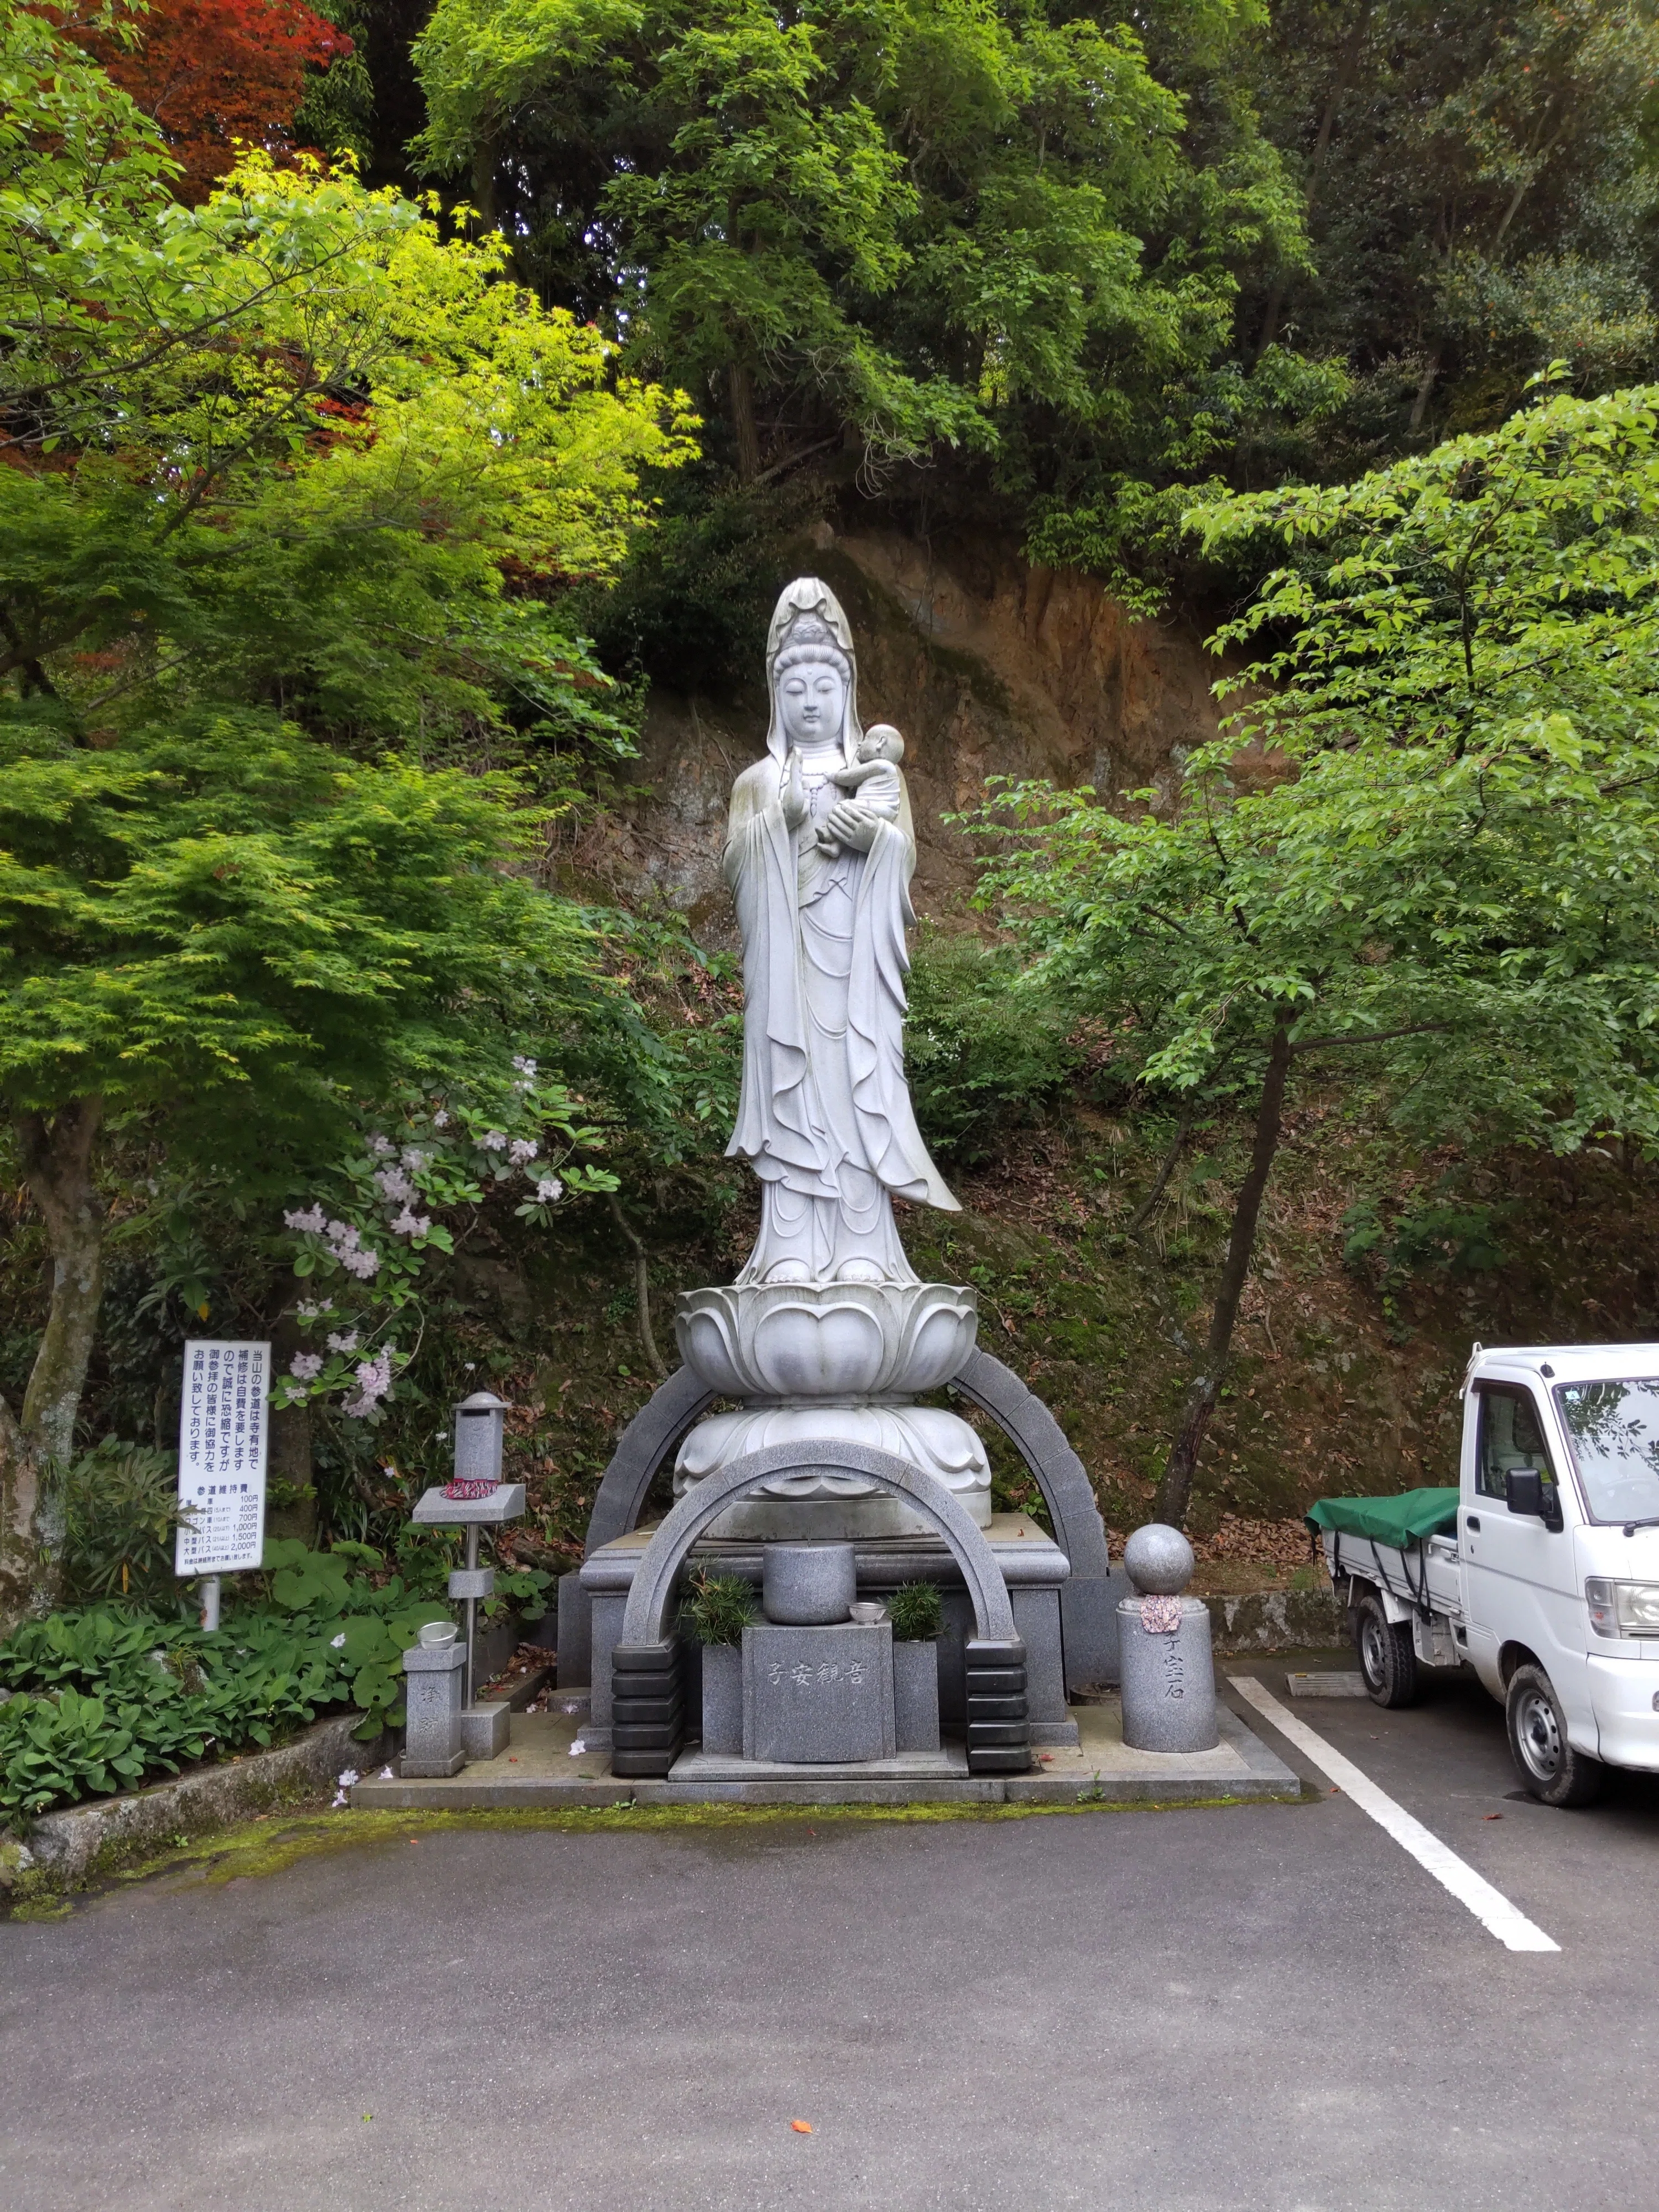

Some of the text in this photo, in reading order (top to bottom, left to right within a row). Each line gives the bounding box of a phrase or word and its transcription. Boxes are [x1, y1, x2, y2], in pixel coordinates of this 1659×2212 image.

[189, 1349, 205, 1467] お願い致しております。
[204, 1349, 220, 1472] 御参拝の皆様に御協力を
[219, 1350, 234, 1472] ので誠に恐縮ですが
[233, 1349, 249, 1471] 補修は自費を要します
[248, 1350, 263, 1470] 当山の参道は寺有地で
[197, 1484, 248, 1495] 参道維持費
[241, 1494, 258, 1503] 100円
[239, 1513, 257, 1521] 700円
[232, 1522, 257, 1532] 1,000円
[232, 1532, 257, 1541] 1,500円
[231, 1541, 256, 1551] 2,000円
